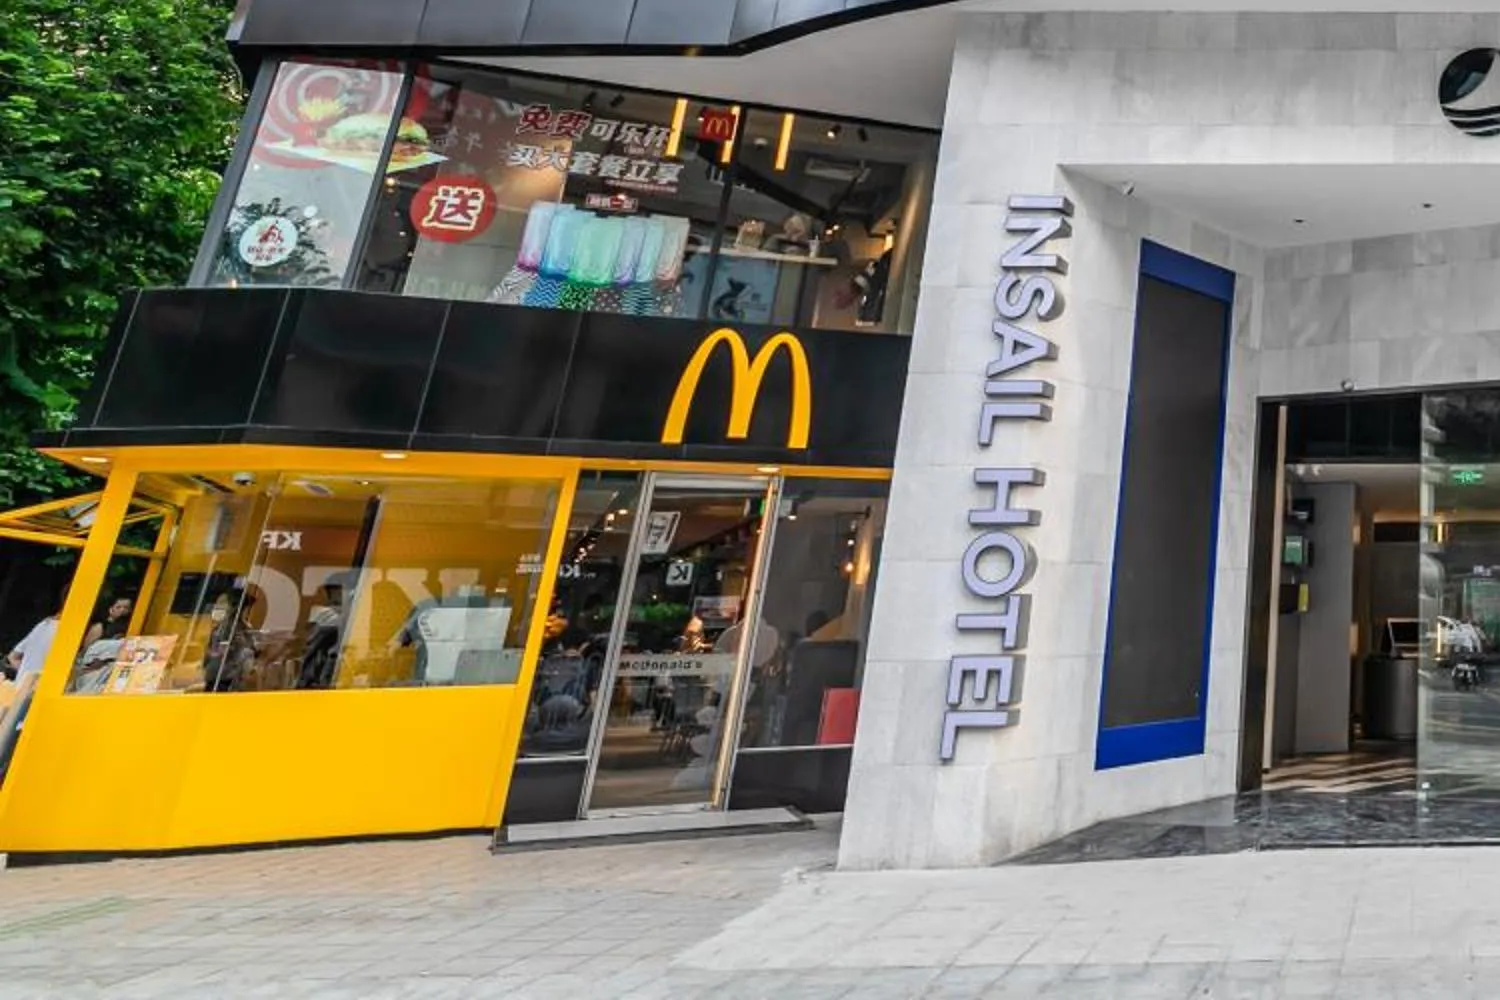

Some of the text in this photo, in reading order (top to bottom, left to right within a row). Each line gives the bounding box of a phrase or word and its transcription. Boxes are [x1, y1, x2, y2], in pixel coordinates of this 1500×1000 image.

[422, 184, 486, 231] 送
[940, 194, 1075, 764] INSAIL HOTEL
